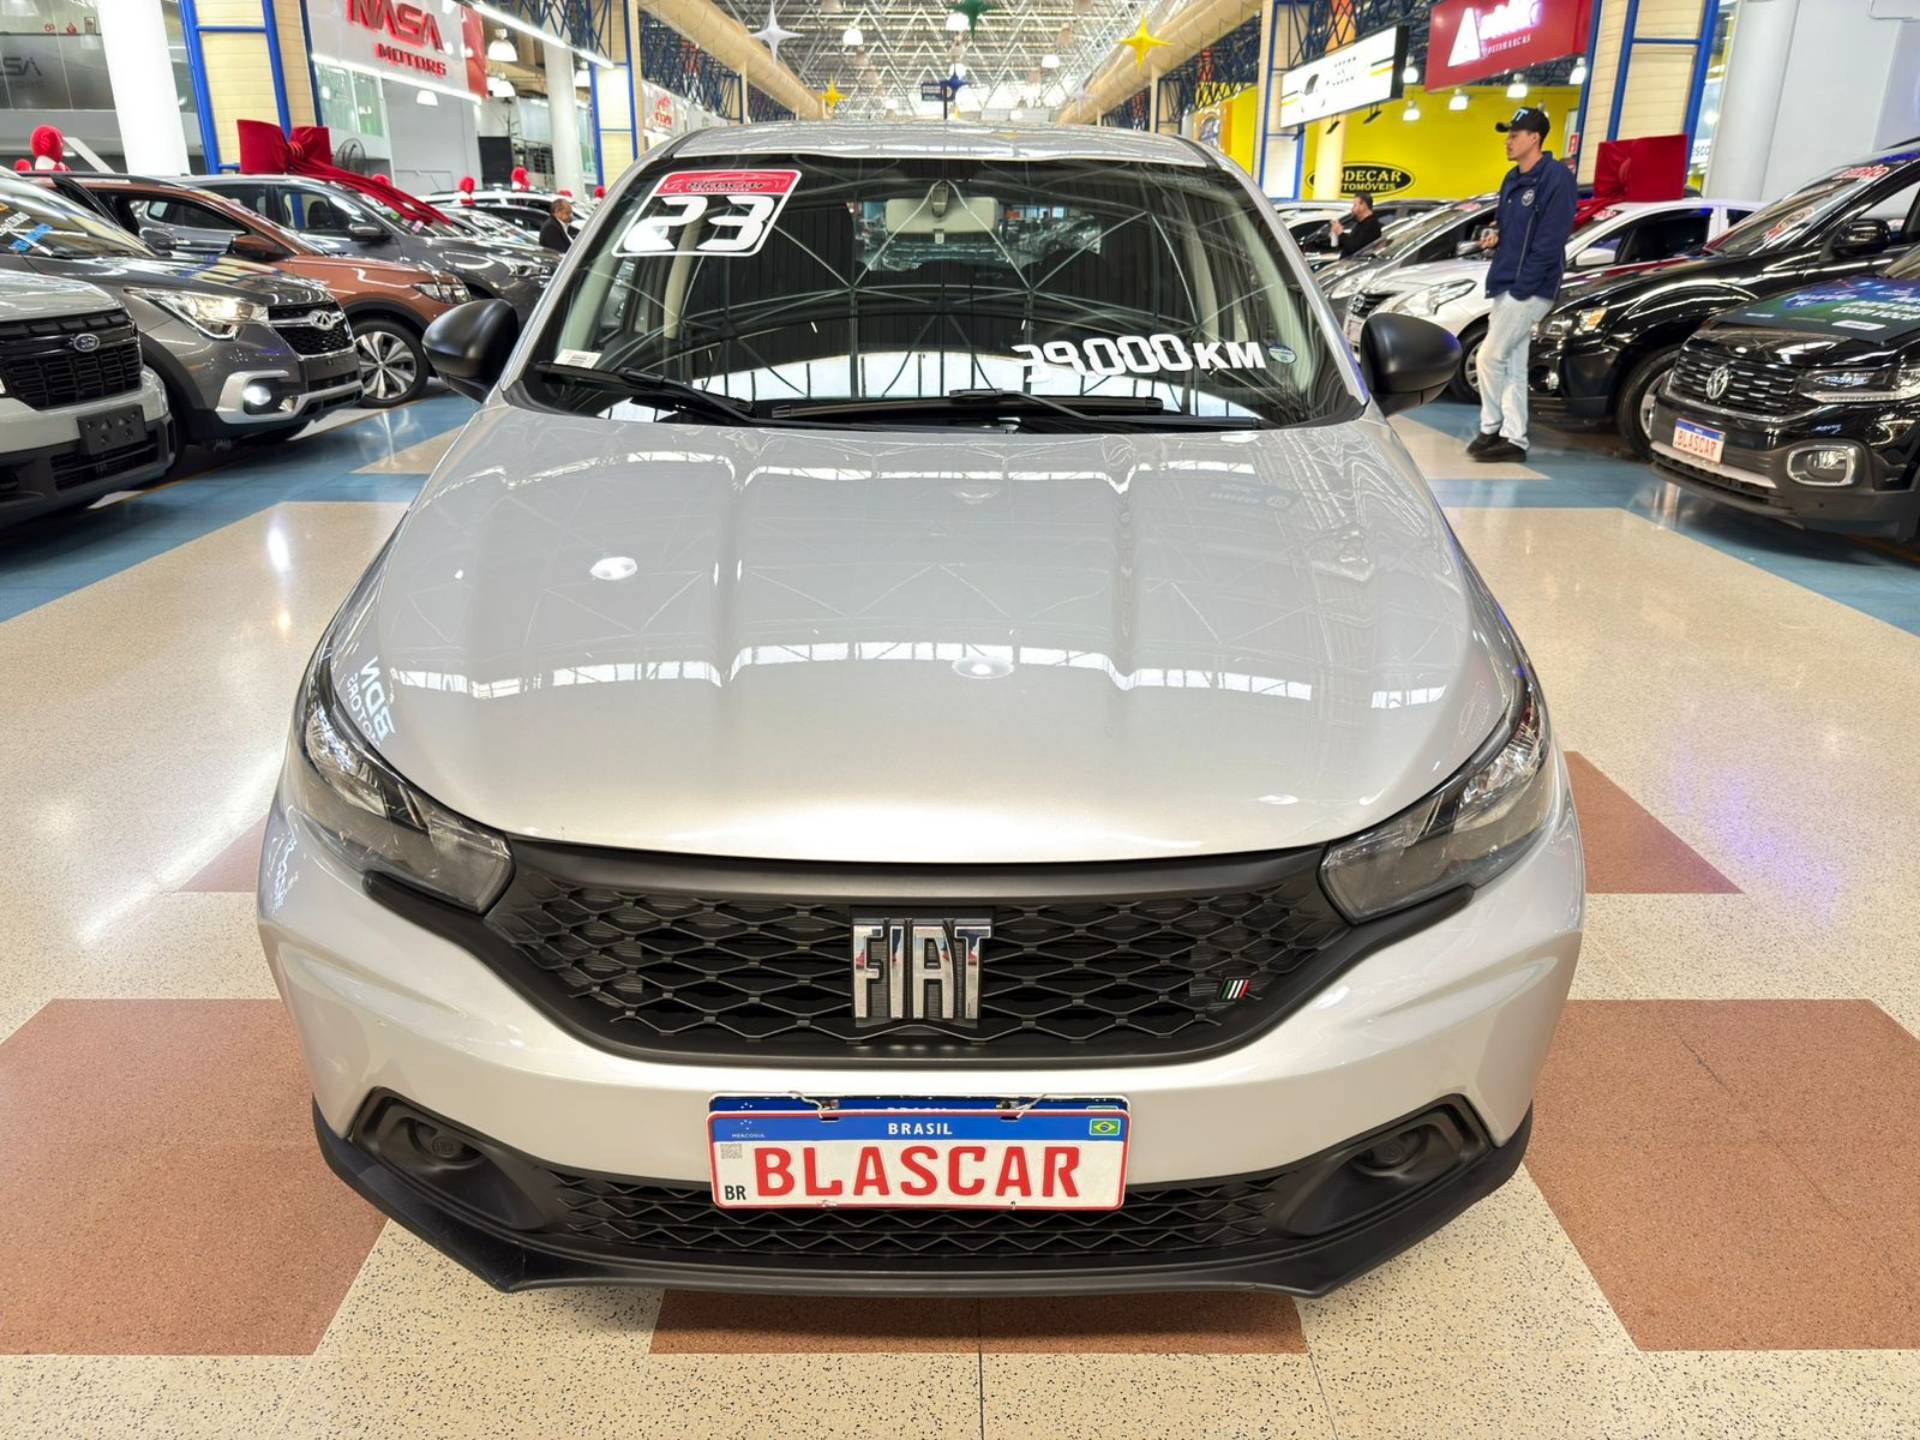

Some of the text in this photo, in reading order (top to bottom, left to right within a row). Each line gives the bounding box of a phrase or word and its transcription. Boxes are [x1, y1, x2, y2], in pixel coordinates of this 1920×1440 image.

[375, 43, 447, 78] MOTORS
[1341, 168, 1402, 182] DECAR
[624, 196, 774, 251] 23
[853, 923, 992, 1020] FIAT
[887, 1122, 953, 1135] BRASIL
[755, 1146, 1080, 1198] BLASCAR
[725, 1185, 747, 1201] BR
